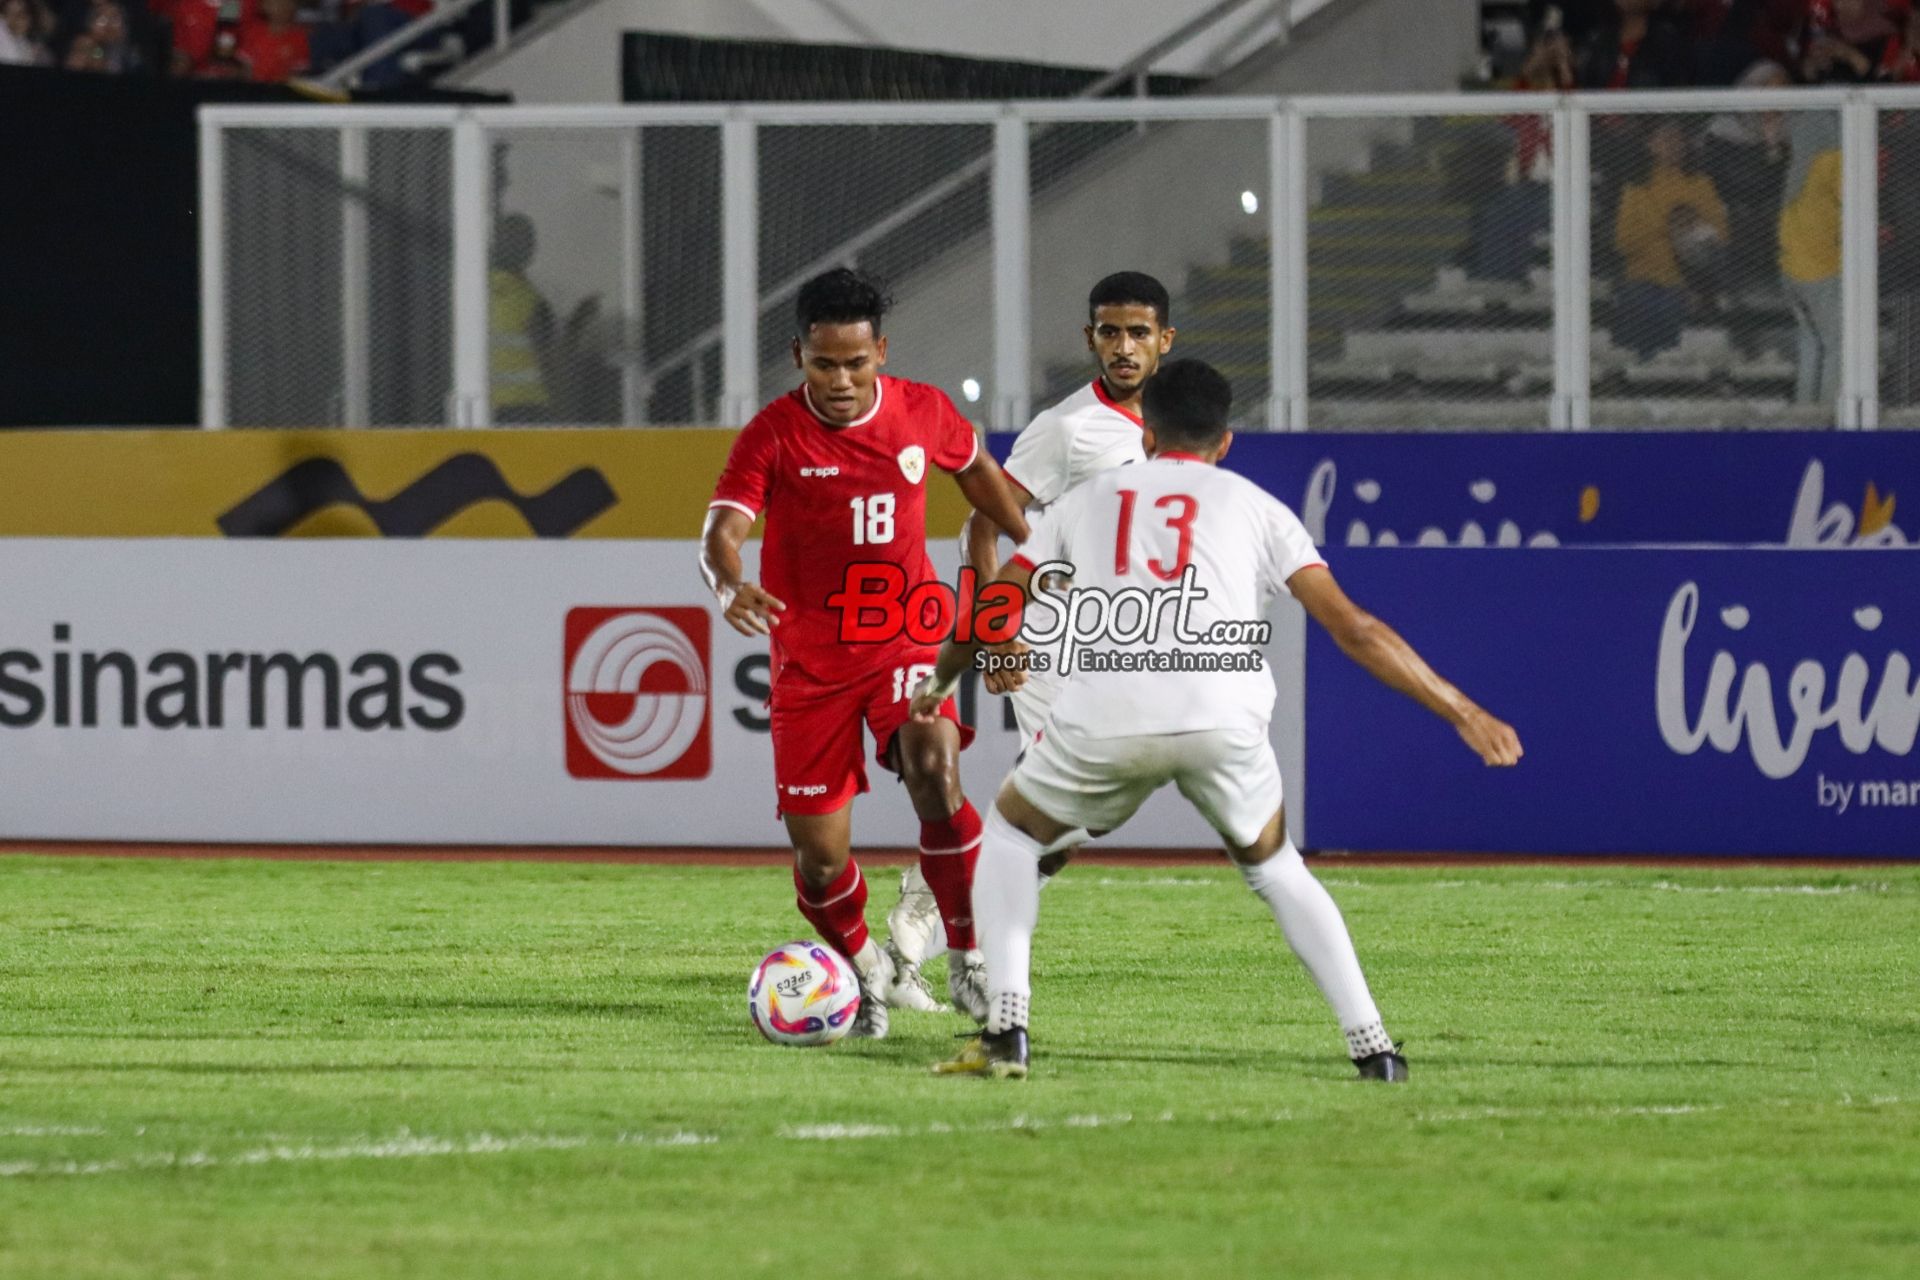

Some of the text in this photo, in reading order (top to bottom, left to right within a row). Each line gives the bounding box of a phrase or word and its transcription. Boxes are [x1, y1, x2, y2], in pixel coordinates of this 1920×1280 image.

[799, 466, 839, 478] erspo
[849, 493, 896, 545] 18
[1113, 488, 1199, 582] 13
[0, 623, 466, 732] sinarmas
[787, 785, 828, 797] erspo
[1816, 773, 1854, 816] by
[776, 970, 813, 993] SPECS
